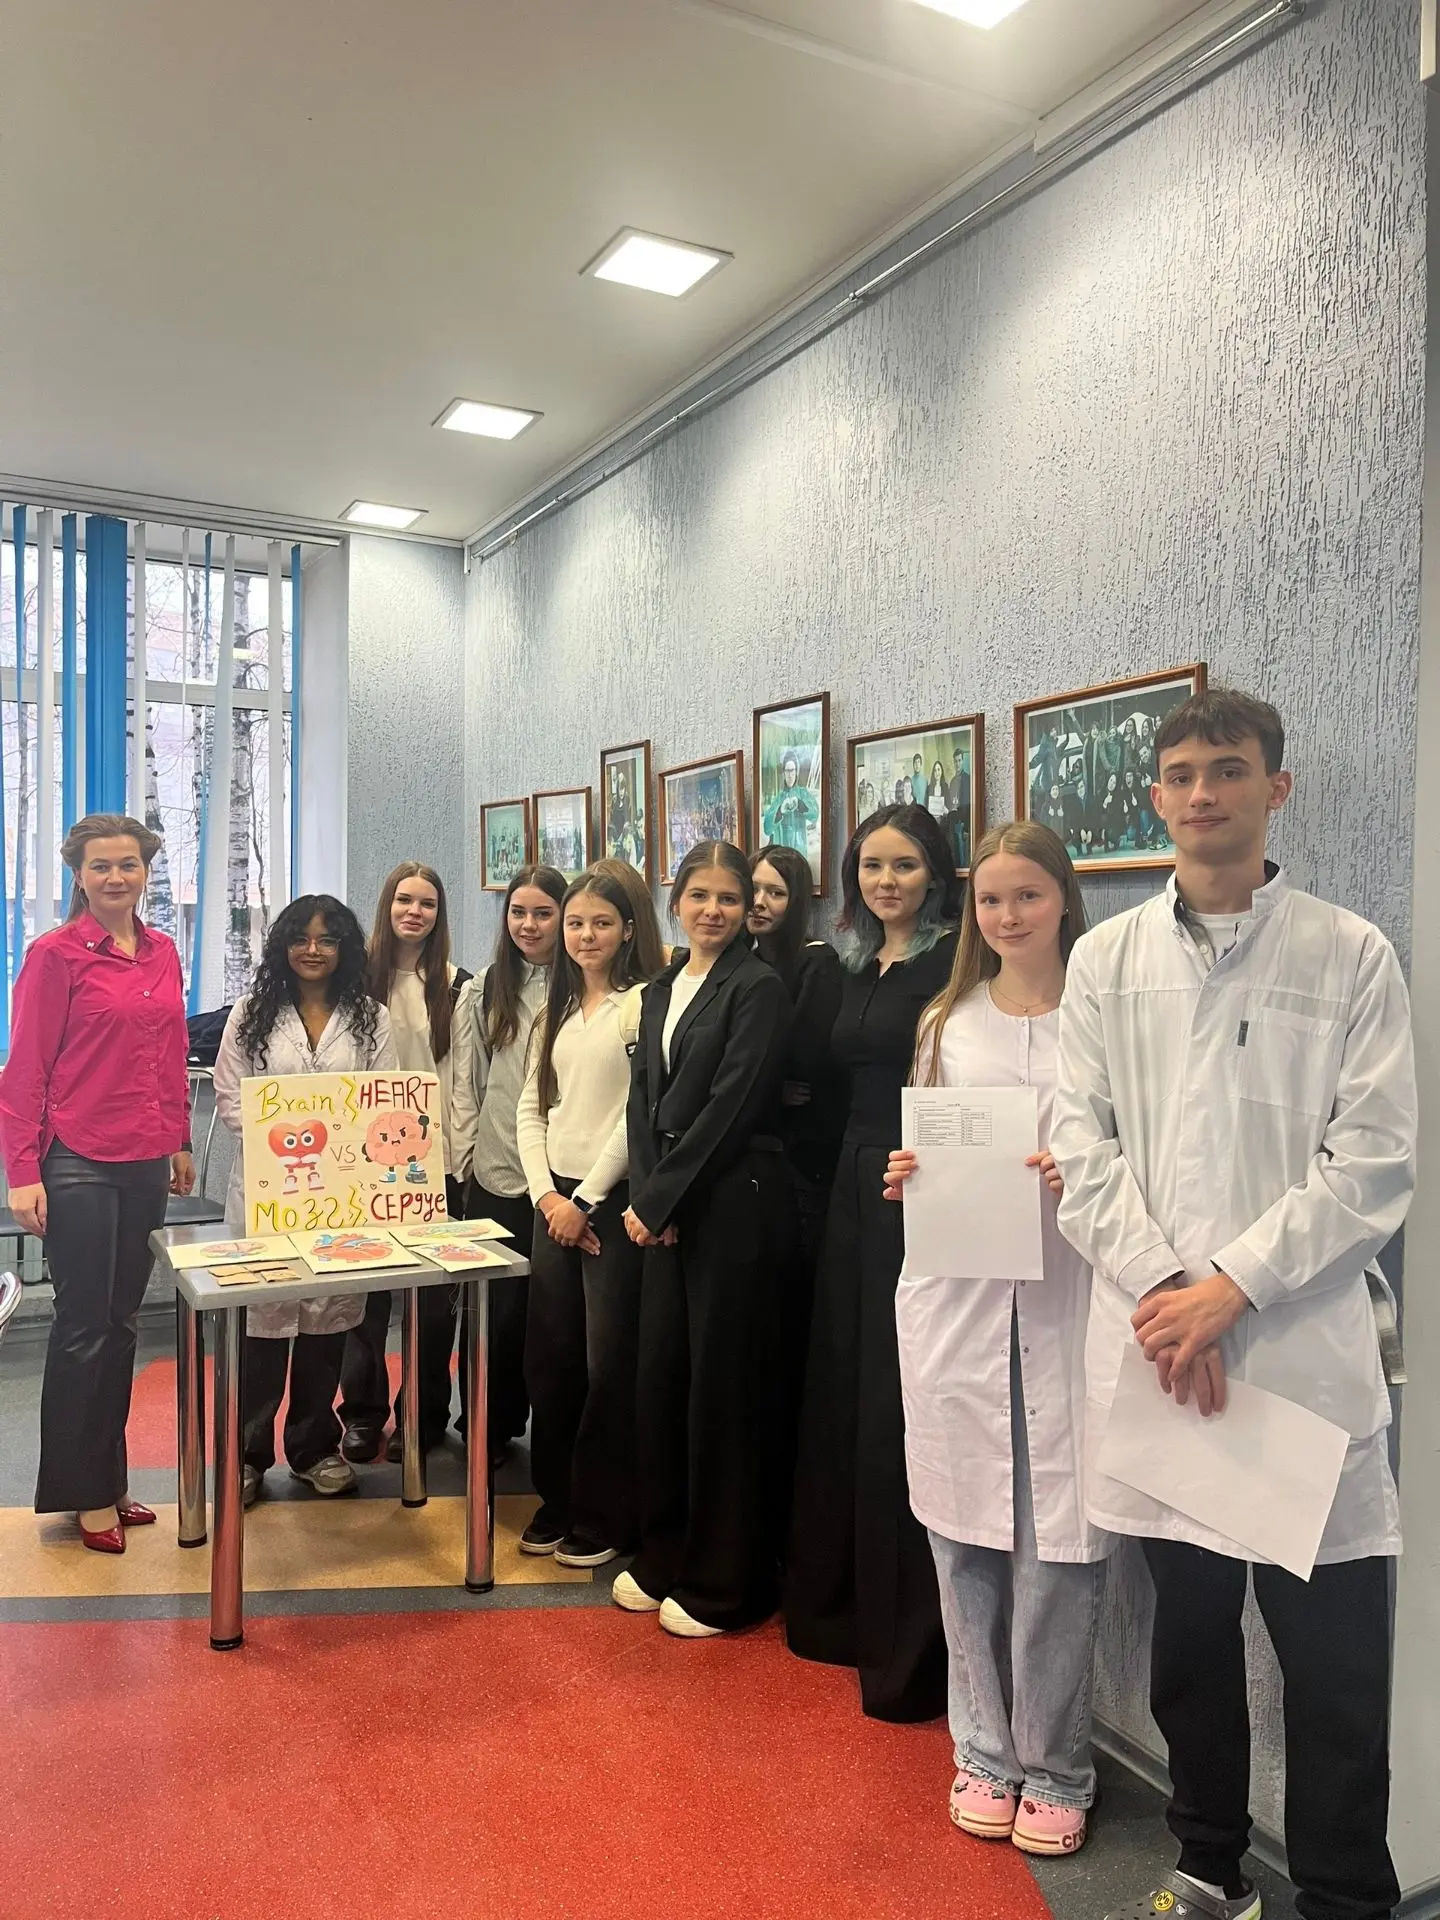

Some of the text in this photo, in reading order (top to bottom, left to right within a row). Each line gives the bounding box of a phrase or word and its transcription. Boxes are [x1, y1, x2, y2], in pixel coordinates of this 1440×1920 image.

[255, 1076, 437, 1123] Brain HEART
[330, 1144, 356, 1164] VS
